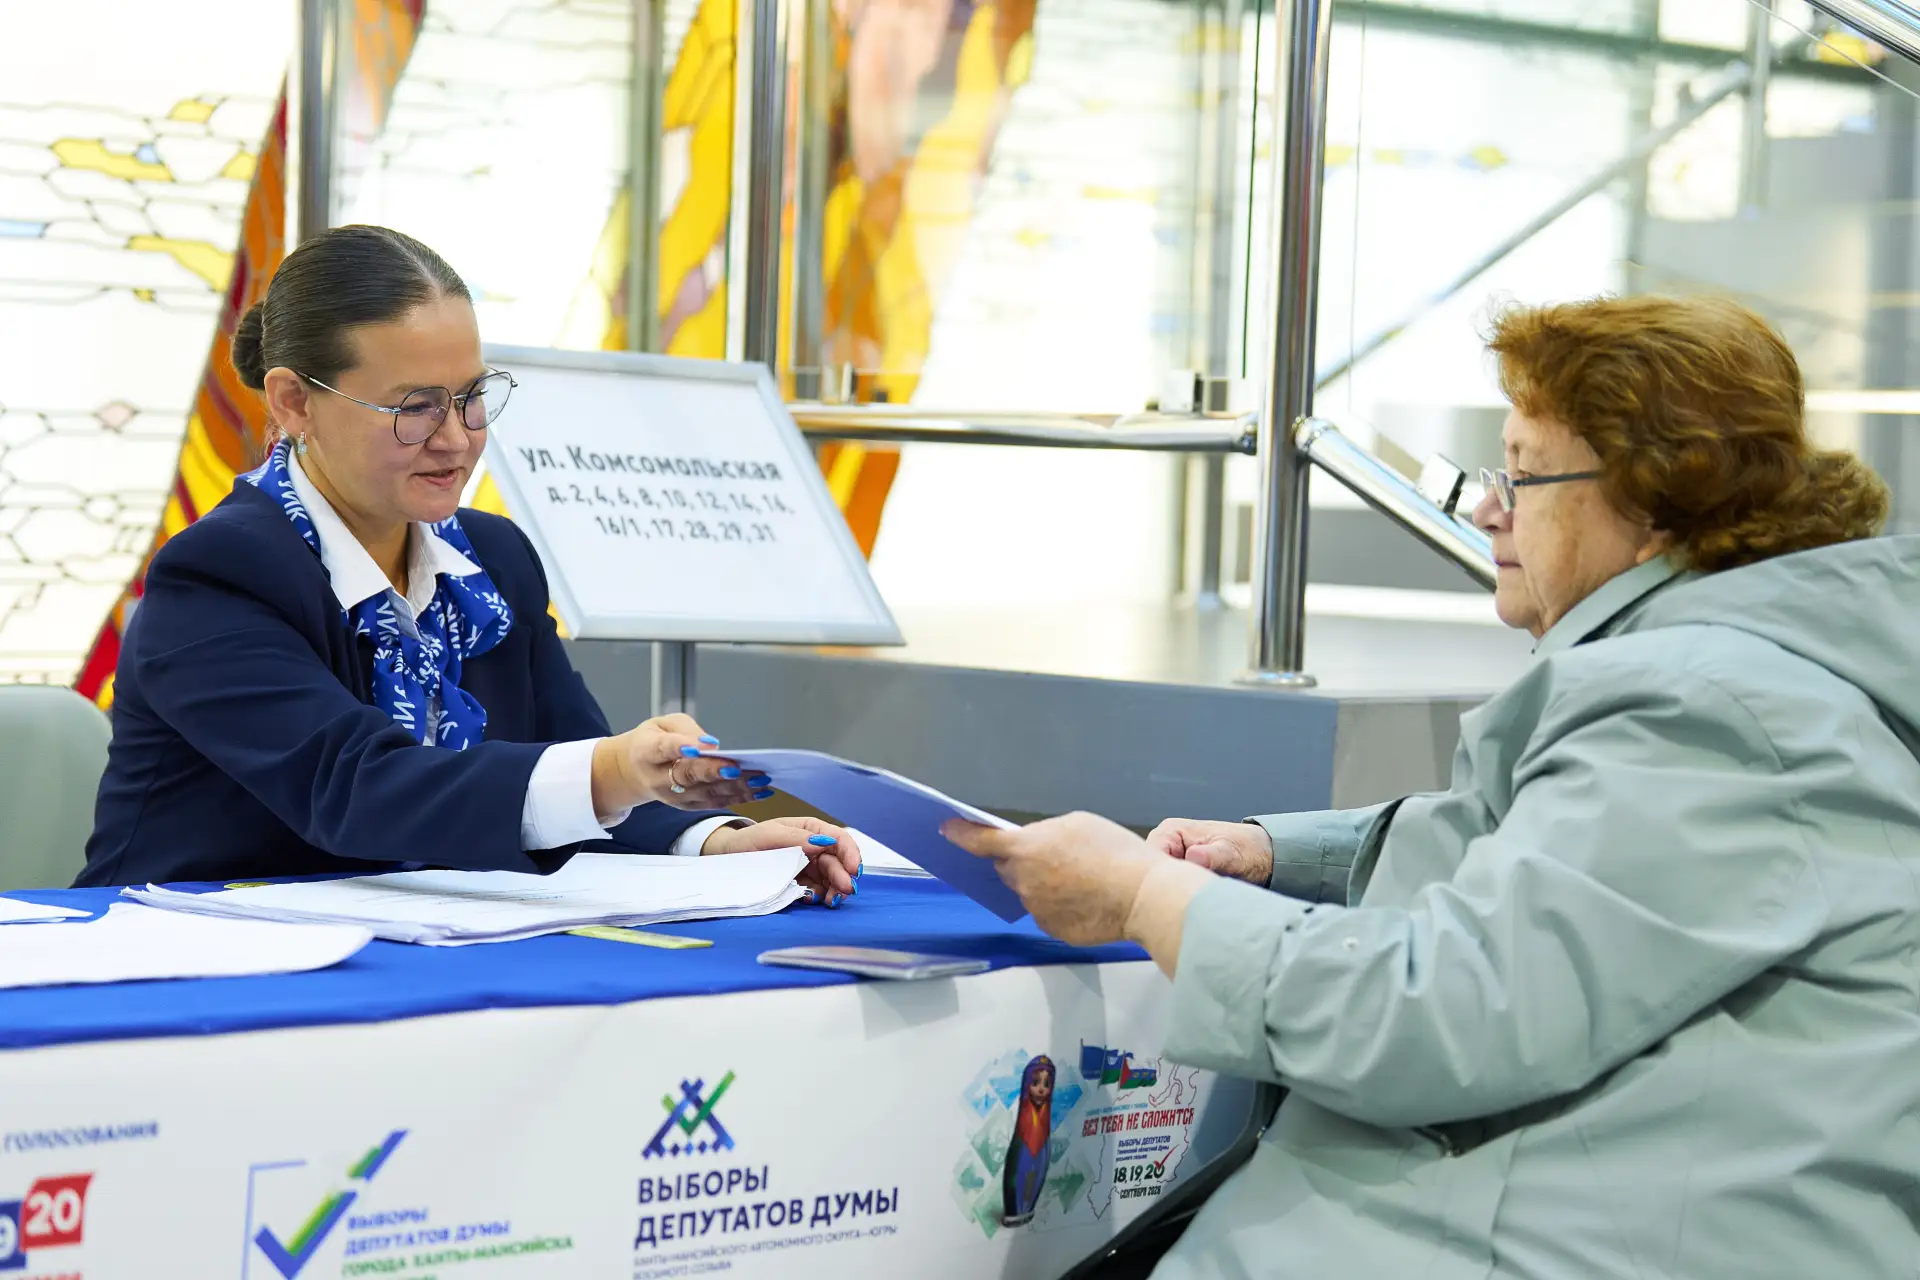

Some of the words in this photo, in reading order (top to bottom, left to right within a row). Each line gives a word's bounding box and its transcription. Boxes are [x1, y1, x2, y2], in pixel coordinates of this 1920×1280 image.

[519, 447, 565, 473] ул.
[566, 445, 784, 480] Комсомольская
[4, 1121, 159, 1152] ГОЛОСОВАНИЯ
[1082, 1116, 1099, 1138] БЕЗ
[1100, 1113, 1124, 1135] ТЕБЯ
[1126, 1112, 1140, 1130] НЕ
[1141, 1107, 1195, 1129] СЛОЖИТСЯ
[1118, 1137, 1141, 1148] ВЫБОРЫ
[1141, 1135, 1171, 1145] ДЕПУТАТОВ
[637, 1165, 769, 1205] ВЫБОРЫ
[1120, 1186, 1147, 1199] СЕНТЯБРЯ
[26, 1187, 82, 1236] 20
[347, 1207, 429, 1231] ВЫБОРЫ
[634, 1199, 804, 1250] ДЕПУТАТОВ
[809, 1187, 899, 1228] ДУМЫ
[344, 1227, 449, 1256] ДЕПУТАТОВ
[454, 1220, 511, 1244] ДУМЫ
